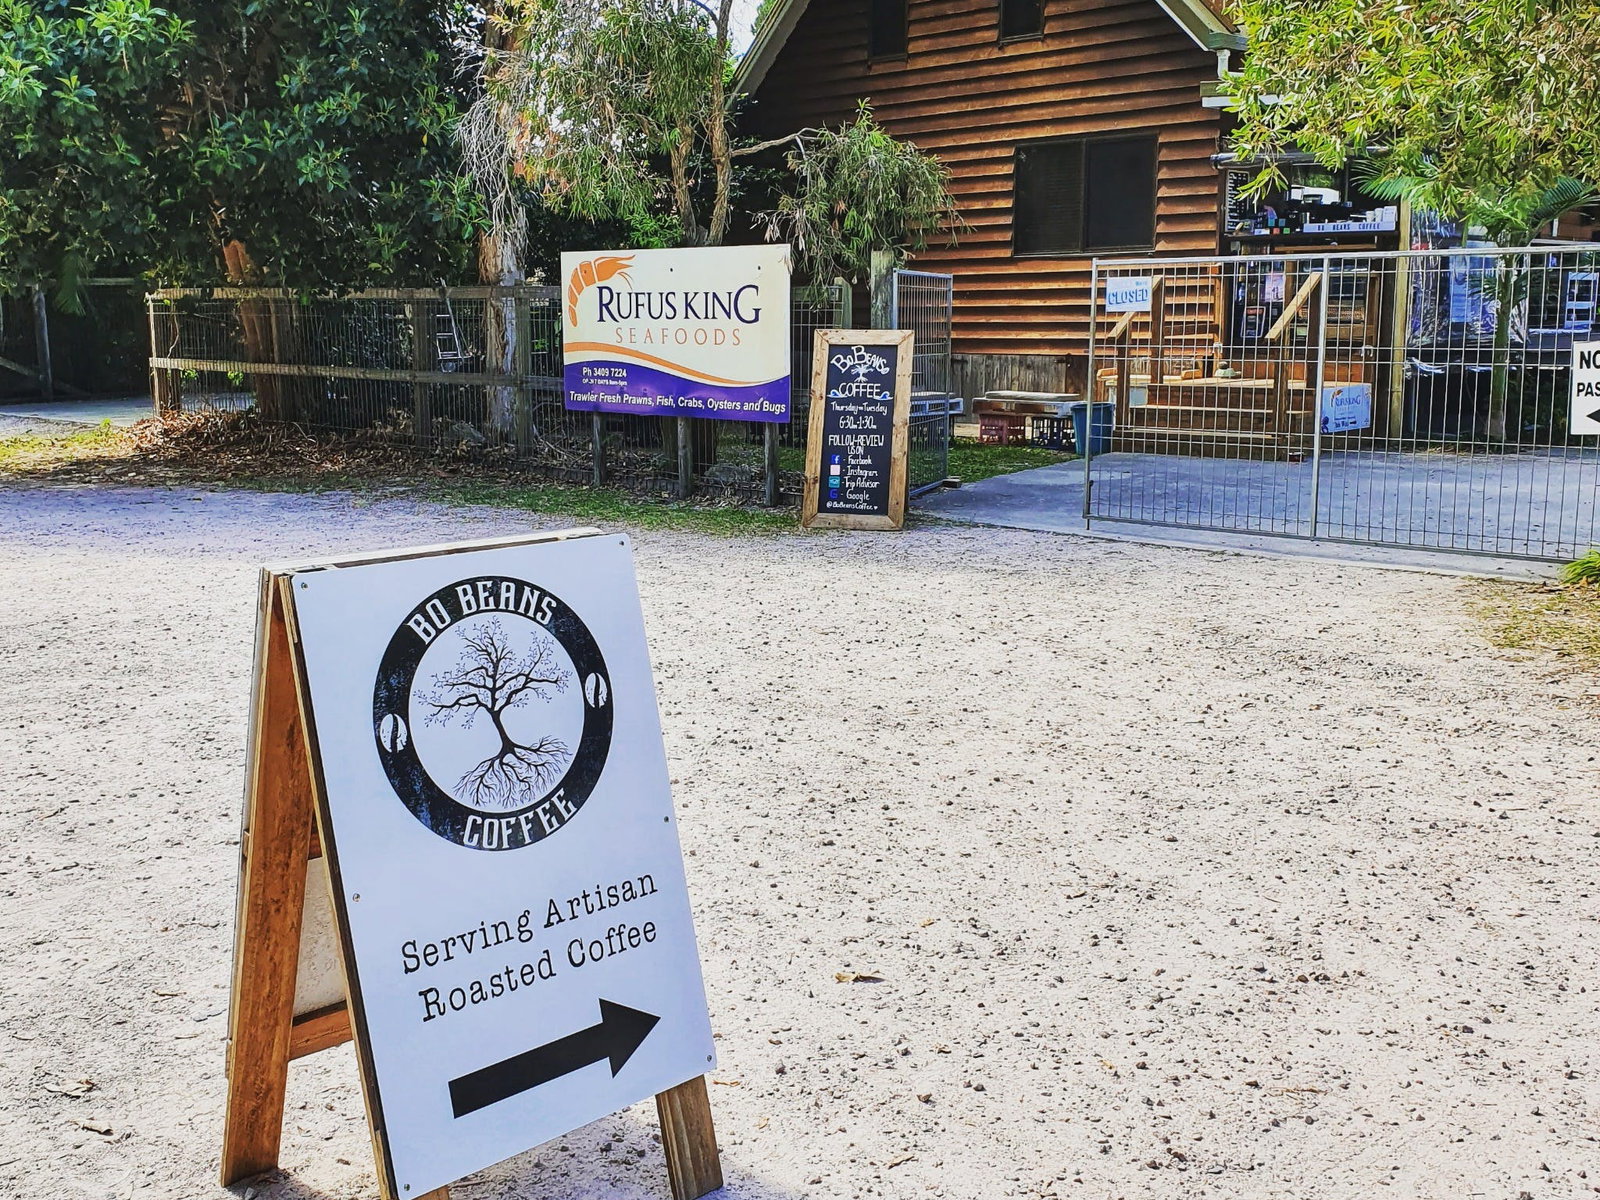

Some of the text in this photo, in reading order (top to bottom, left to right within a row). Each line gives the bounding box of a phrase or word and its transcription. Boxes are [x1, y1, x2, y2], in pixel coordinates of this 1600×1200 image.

[1358, 222, 1380, 230] COFFEE
[597, 284, 762, 324] RUFUS KING
[1108, 288, 1148, 305] CLOSED
[615, 327, 741, 346] SEAFOODS
[582, 366, 627, 377] Ph 3409 7224
[839, 382, 881, 398] COFFEE
[569, 391, 786, 415] Trawler Fresh Prawns, Fish, Crabs, Oysters and Bugs
[848, 455, 872, 465] Facebook
[847, 465, 878, 480] Instagram
[846, 489, 870, 503] Google
[407, 580, 557, 645] BO BEANS
[463, 787, 577, 849] COFFEE
[401, 874, 658, 974] Serving Artisan
[418, 921, 657, 1022] Roasted Coffee
